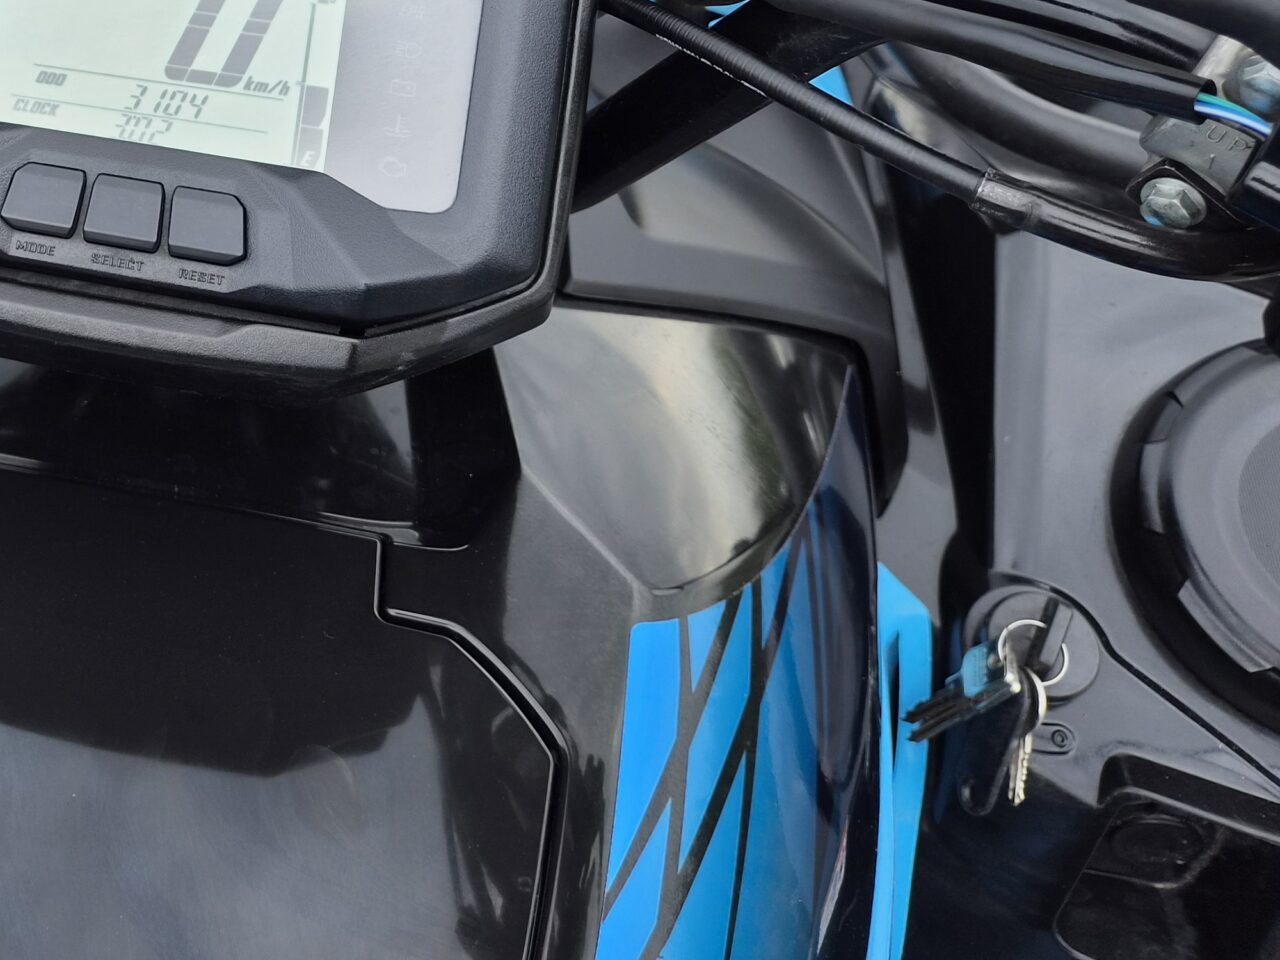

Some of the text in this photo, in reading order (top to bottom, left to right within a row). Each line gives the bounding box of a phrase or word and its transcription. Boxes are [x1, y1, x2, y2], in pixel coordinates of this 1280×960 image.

[243, 75, 291, 97] km/h
[11, 97, 61, 117] CLOCK
[124, 84, 209, 120] 3104
[1206, 124, 1250, 152] UP
[299, 150, 316, 167] E
[15, 239, 57, 257] MODE
[90, 252, 145, 272] SELECT
[178, 267, 226, 286] RESET
